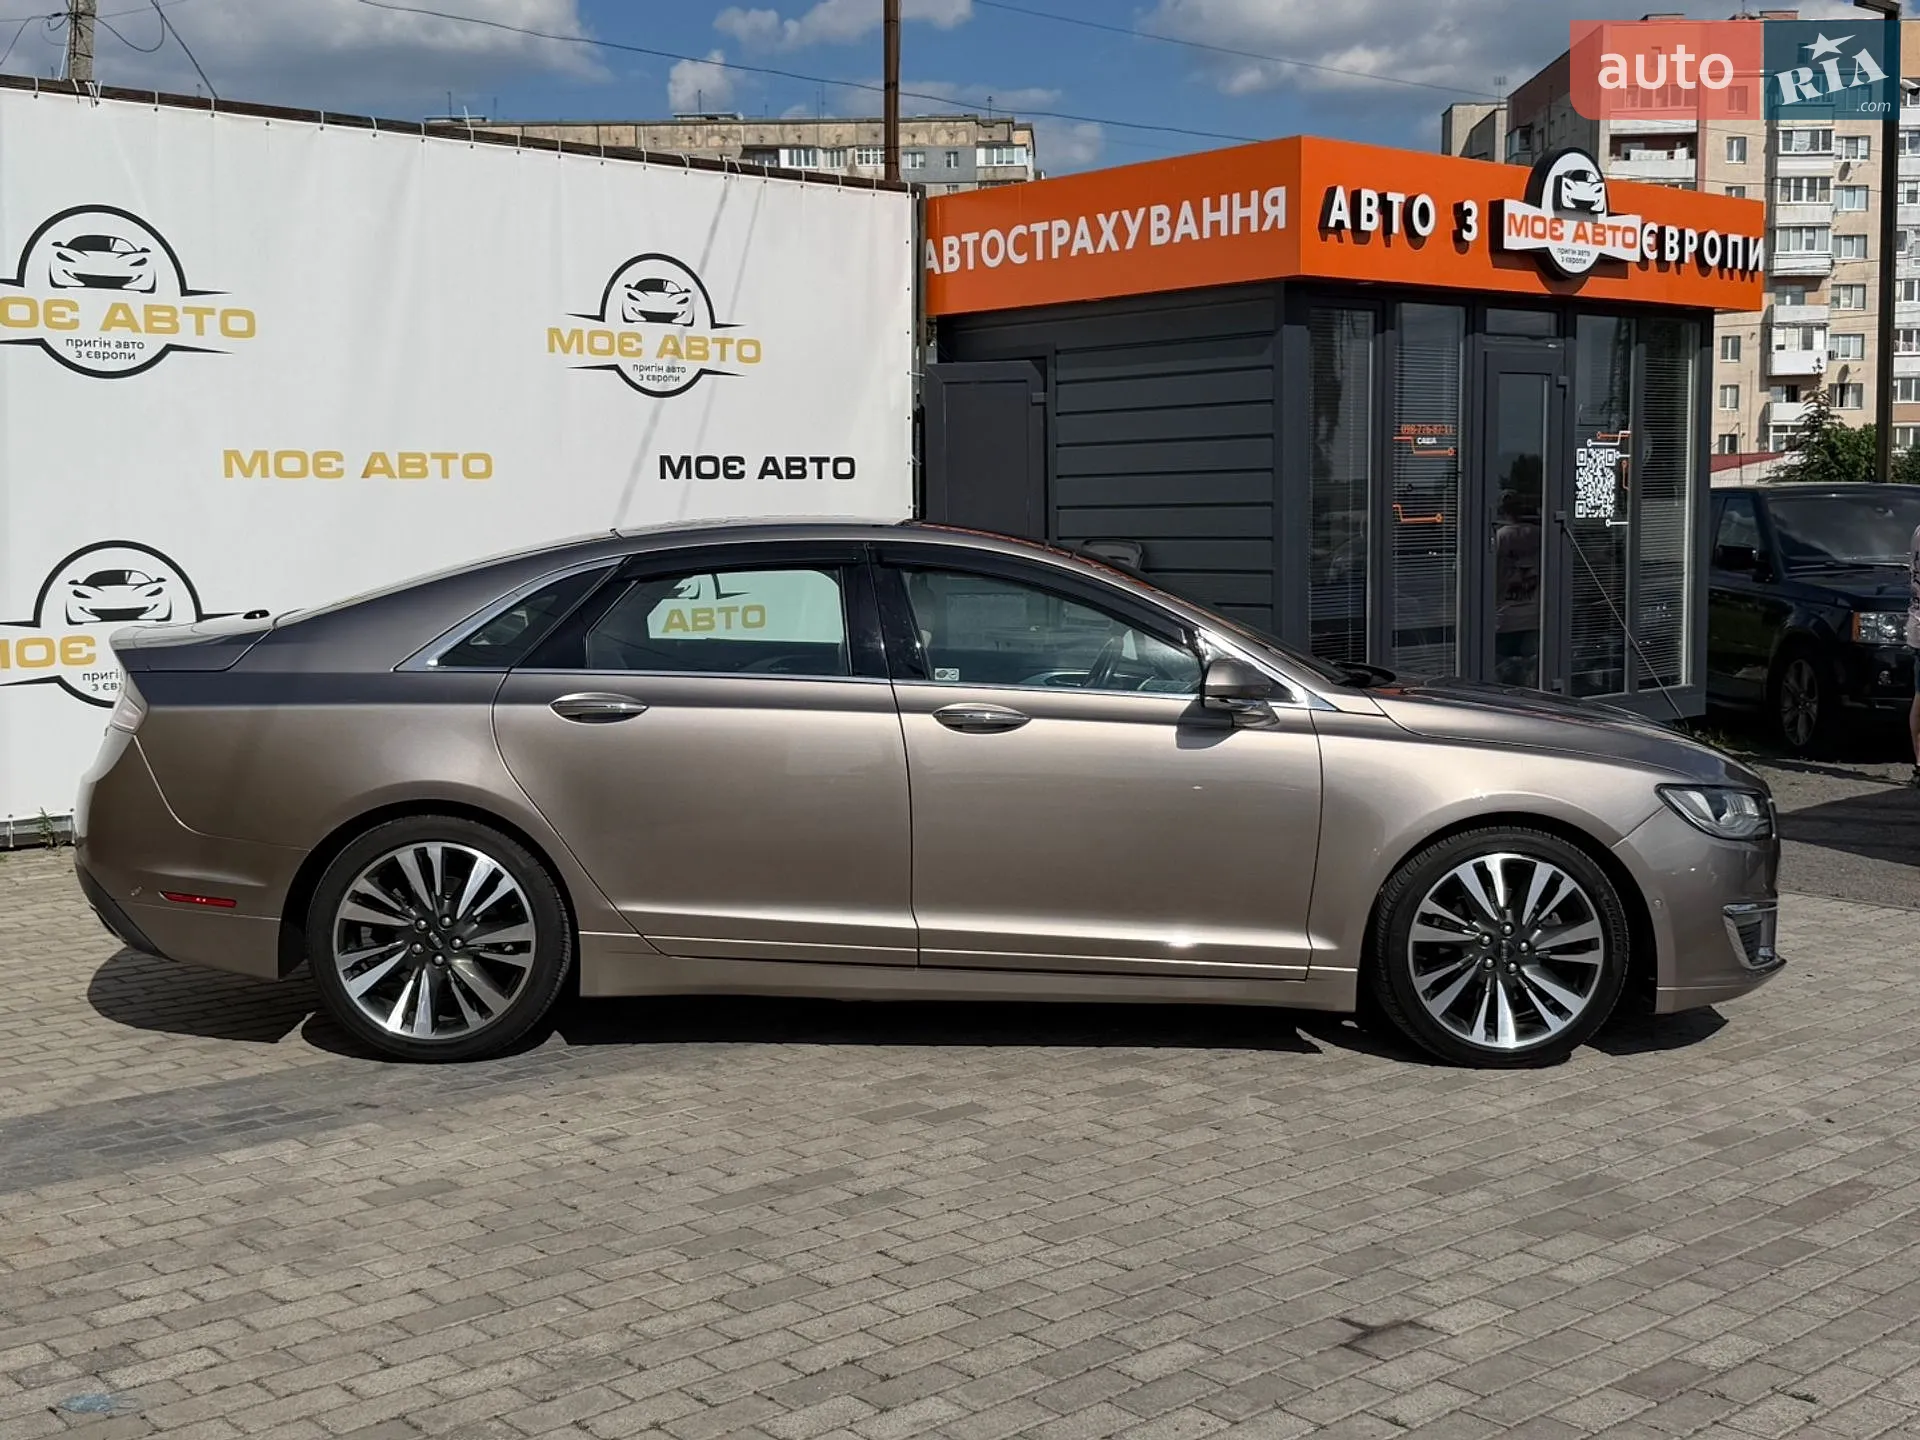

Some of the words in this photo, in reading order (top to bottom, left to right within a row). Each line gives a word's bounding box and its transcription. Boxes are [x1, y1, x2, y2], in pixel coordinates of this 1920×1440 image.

[925, 186, 1287, 275] АВТОСТРАХУВАННЯ
[1327, 185, 1436, 238] АВТО
[1641, 221, 1764, 273] ЄВРОПИ
[1507, 212, 1564, 242] МОЄ
[1571, 219, 1638, 250] АВТО
[100, 302, 256, 339] АВТО
[66, 337, 111, 350] пригін
[115, 339, 145, 350] авто
[75, 350, 82, 360] з
[86, 350, 136, 361] європи
[546, 327, 643, 358] МОЄ
[655, 334, 762, 364] АВТО
[633, 363, 664, 373] пригін
[223, 449, 345, 480] МОЄ
[361, 450, 494, 480] АВТО
[659, 454, 746, 480] МОЄ
[757, 455, 856, 480] АВТО
[662, 604, 767, 633] АВТО
